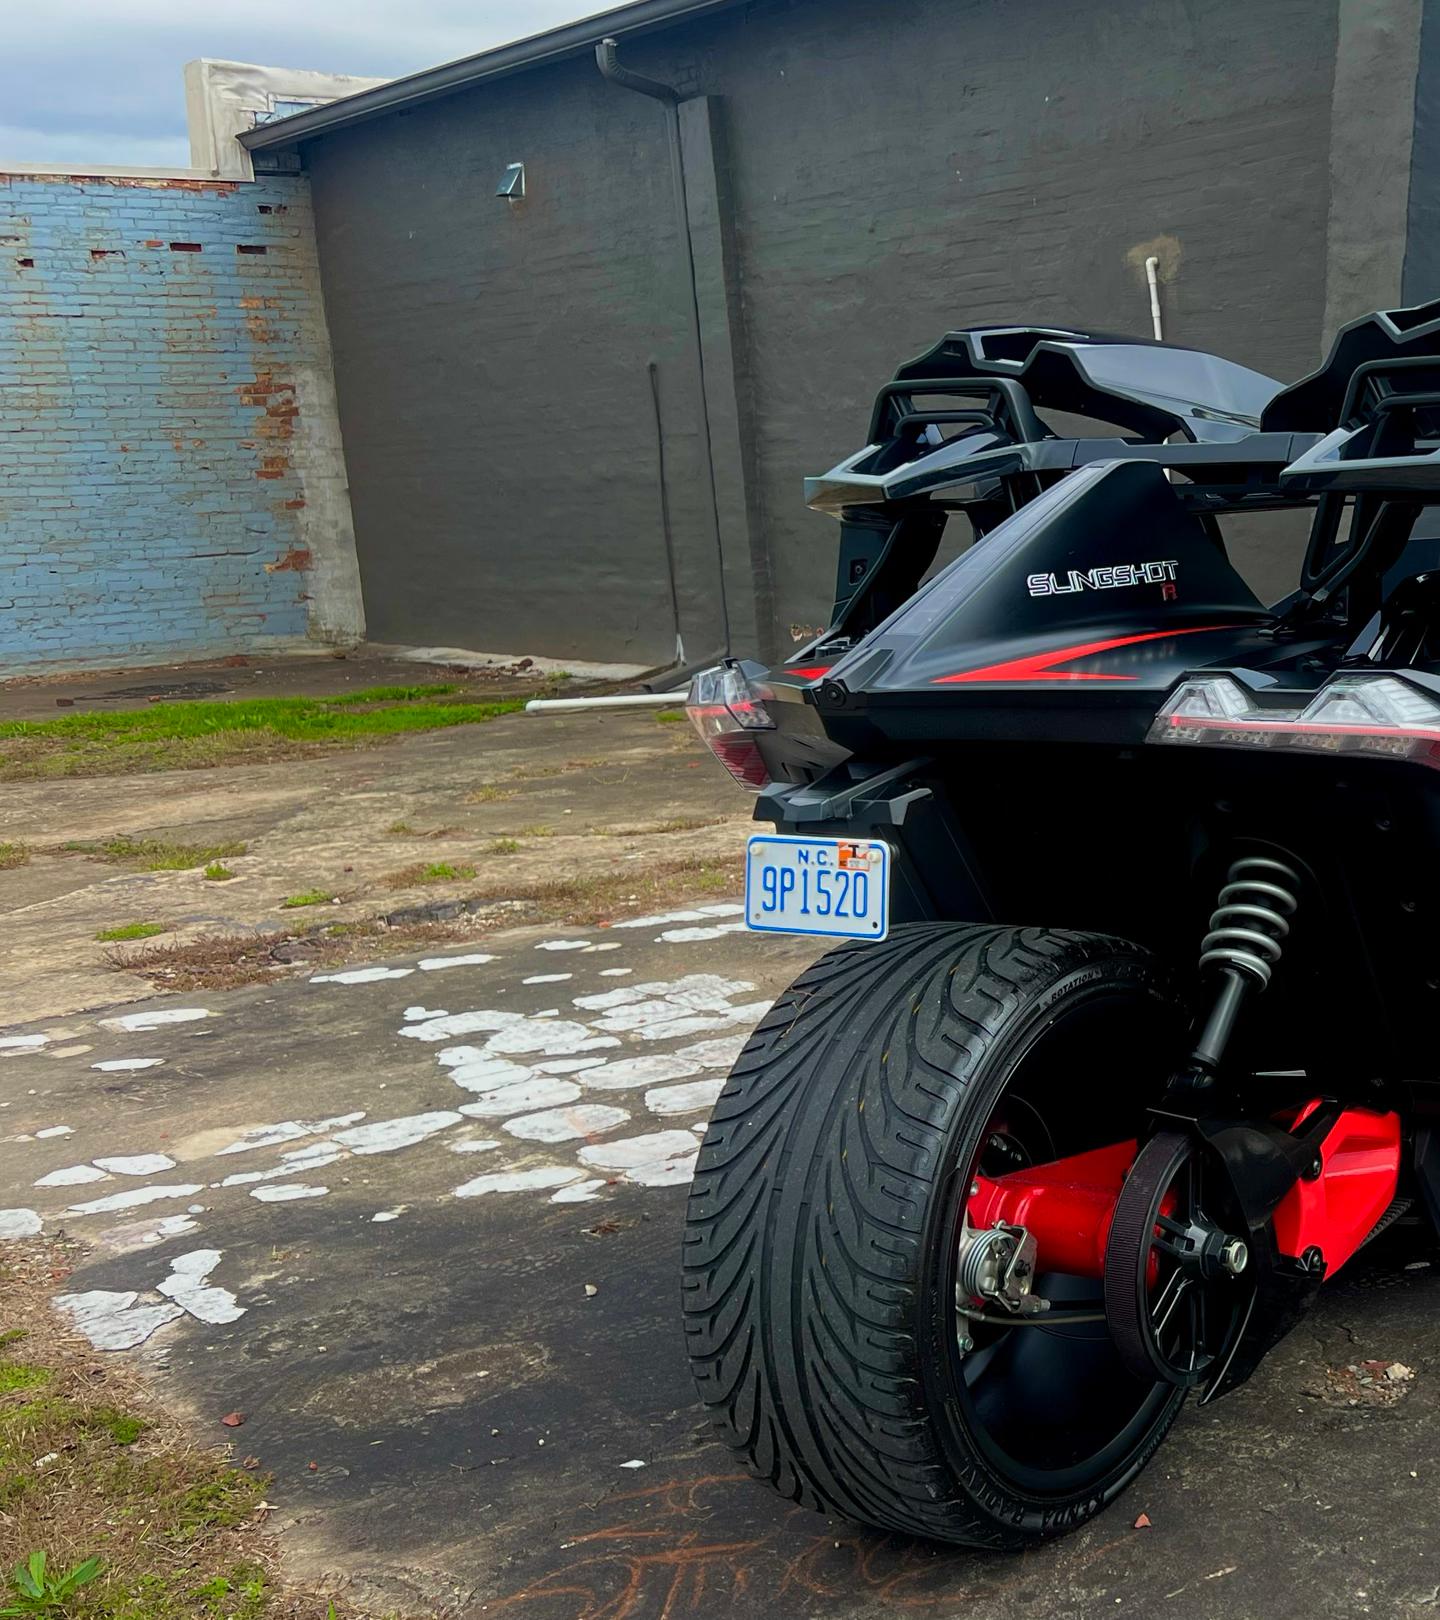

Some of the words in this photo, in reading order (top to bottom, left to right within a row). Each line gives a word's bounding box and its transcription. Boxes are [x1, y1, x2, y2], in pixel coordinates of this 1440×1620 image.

[1026, 560, 1179, 597] SLINGSHOT
[1160, 582, 1178, 601] R
[797, 849, 834, 866] N.C.
[762, 865, 869, 918] 9P1520
